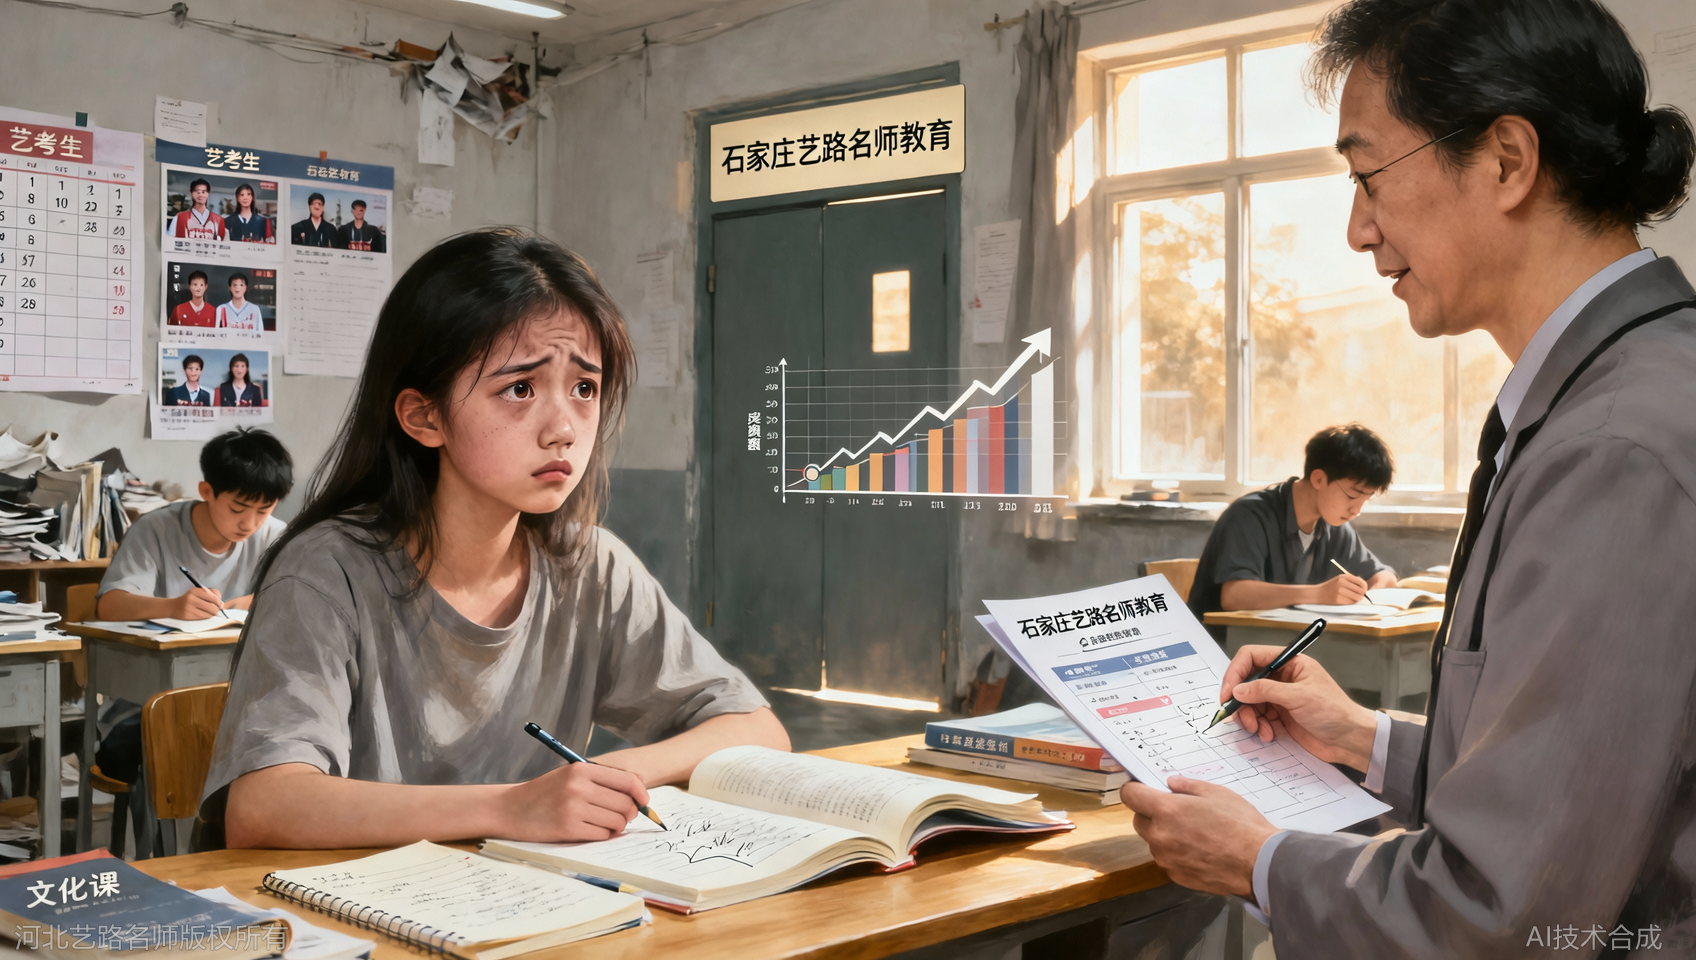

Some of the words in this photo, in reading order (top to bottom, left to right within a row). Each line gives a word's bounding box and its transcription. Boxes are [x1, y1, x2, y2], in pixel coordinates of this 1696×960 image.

[9, 126, 84, 159] 艺考生
[204, 147, 261, 172] 艺考生
[721, 118, 953, 175] 石家庄艺路名师教育
[1016, 592, 1169, 640] 石家庄艺路名师教育
[26, 870, 122, 909] 文化课
